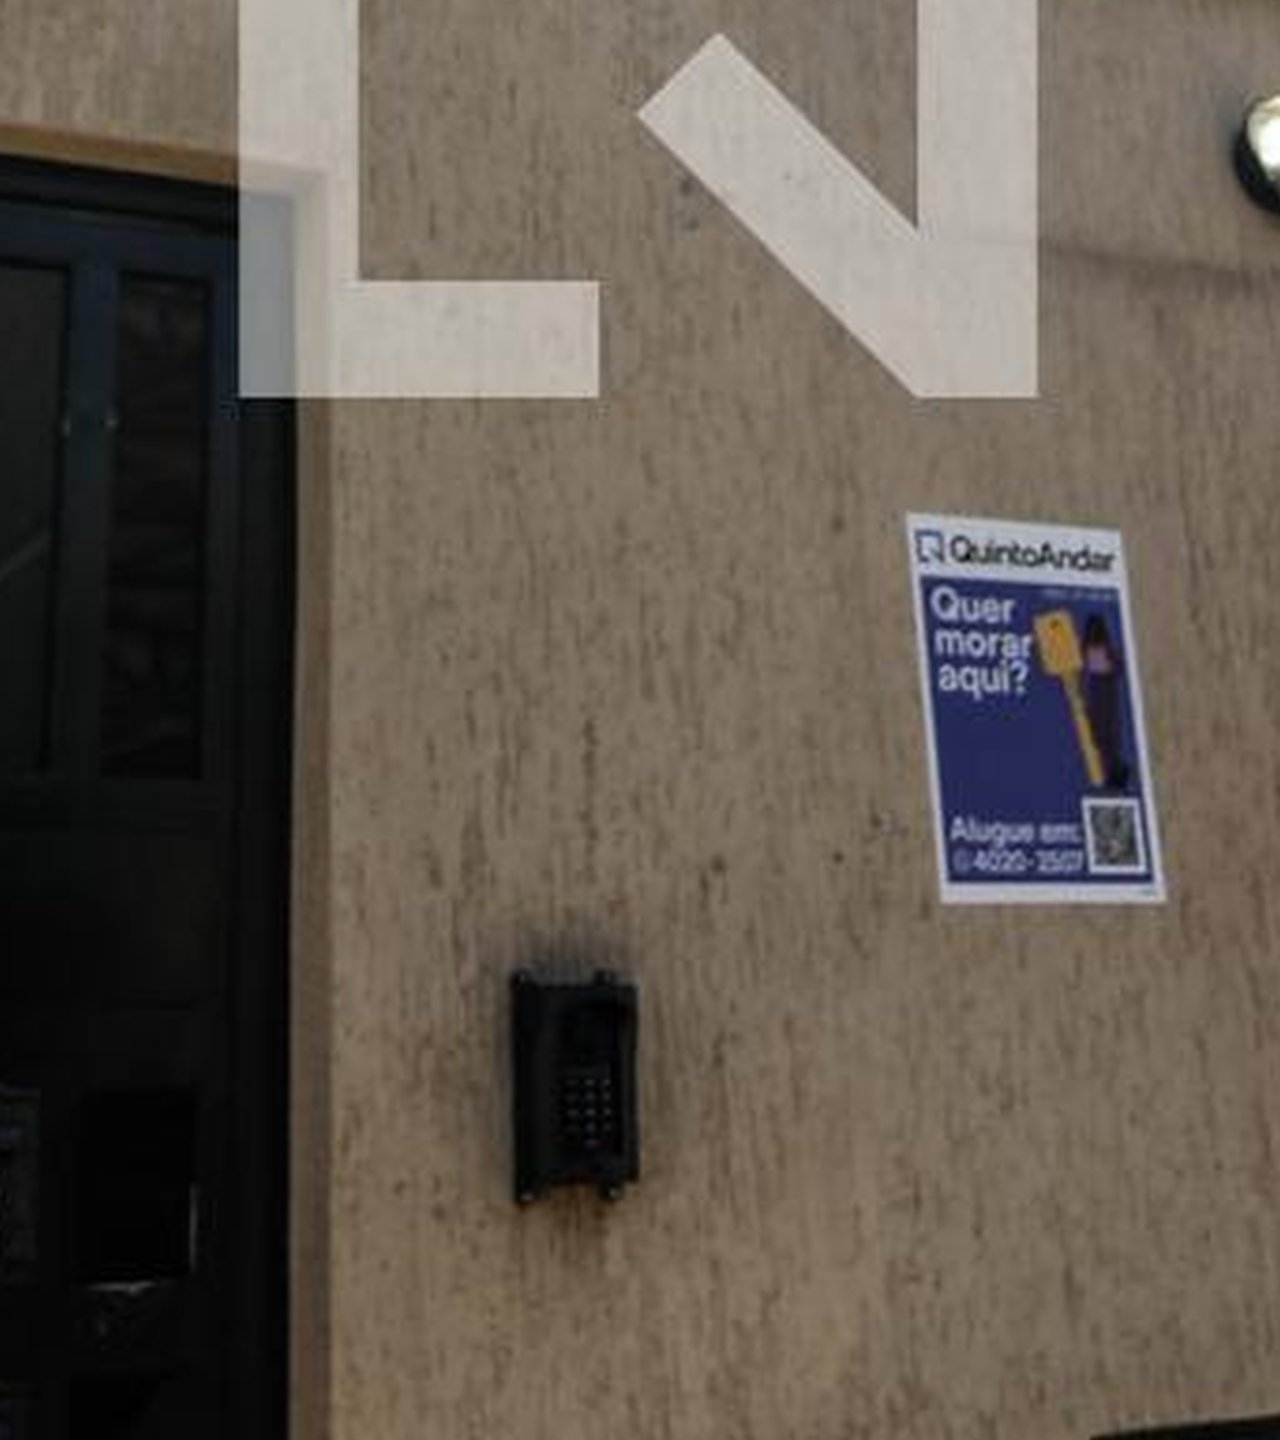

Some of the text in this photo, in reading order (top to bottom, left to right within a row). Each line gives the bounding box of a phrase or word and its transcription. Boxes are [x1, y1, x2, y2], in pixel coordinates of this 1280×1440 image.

[950, 534, 1116, 571] QuintoAndar
[931, 586, 1015, 623] Quer
[934, 627, 1032, 658] morar
[939, 661, 1029, 699] aqui?
[951, 816, 1034, 848] Alugue
